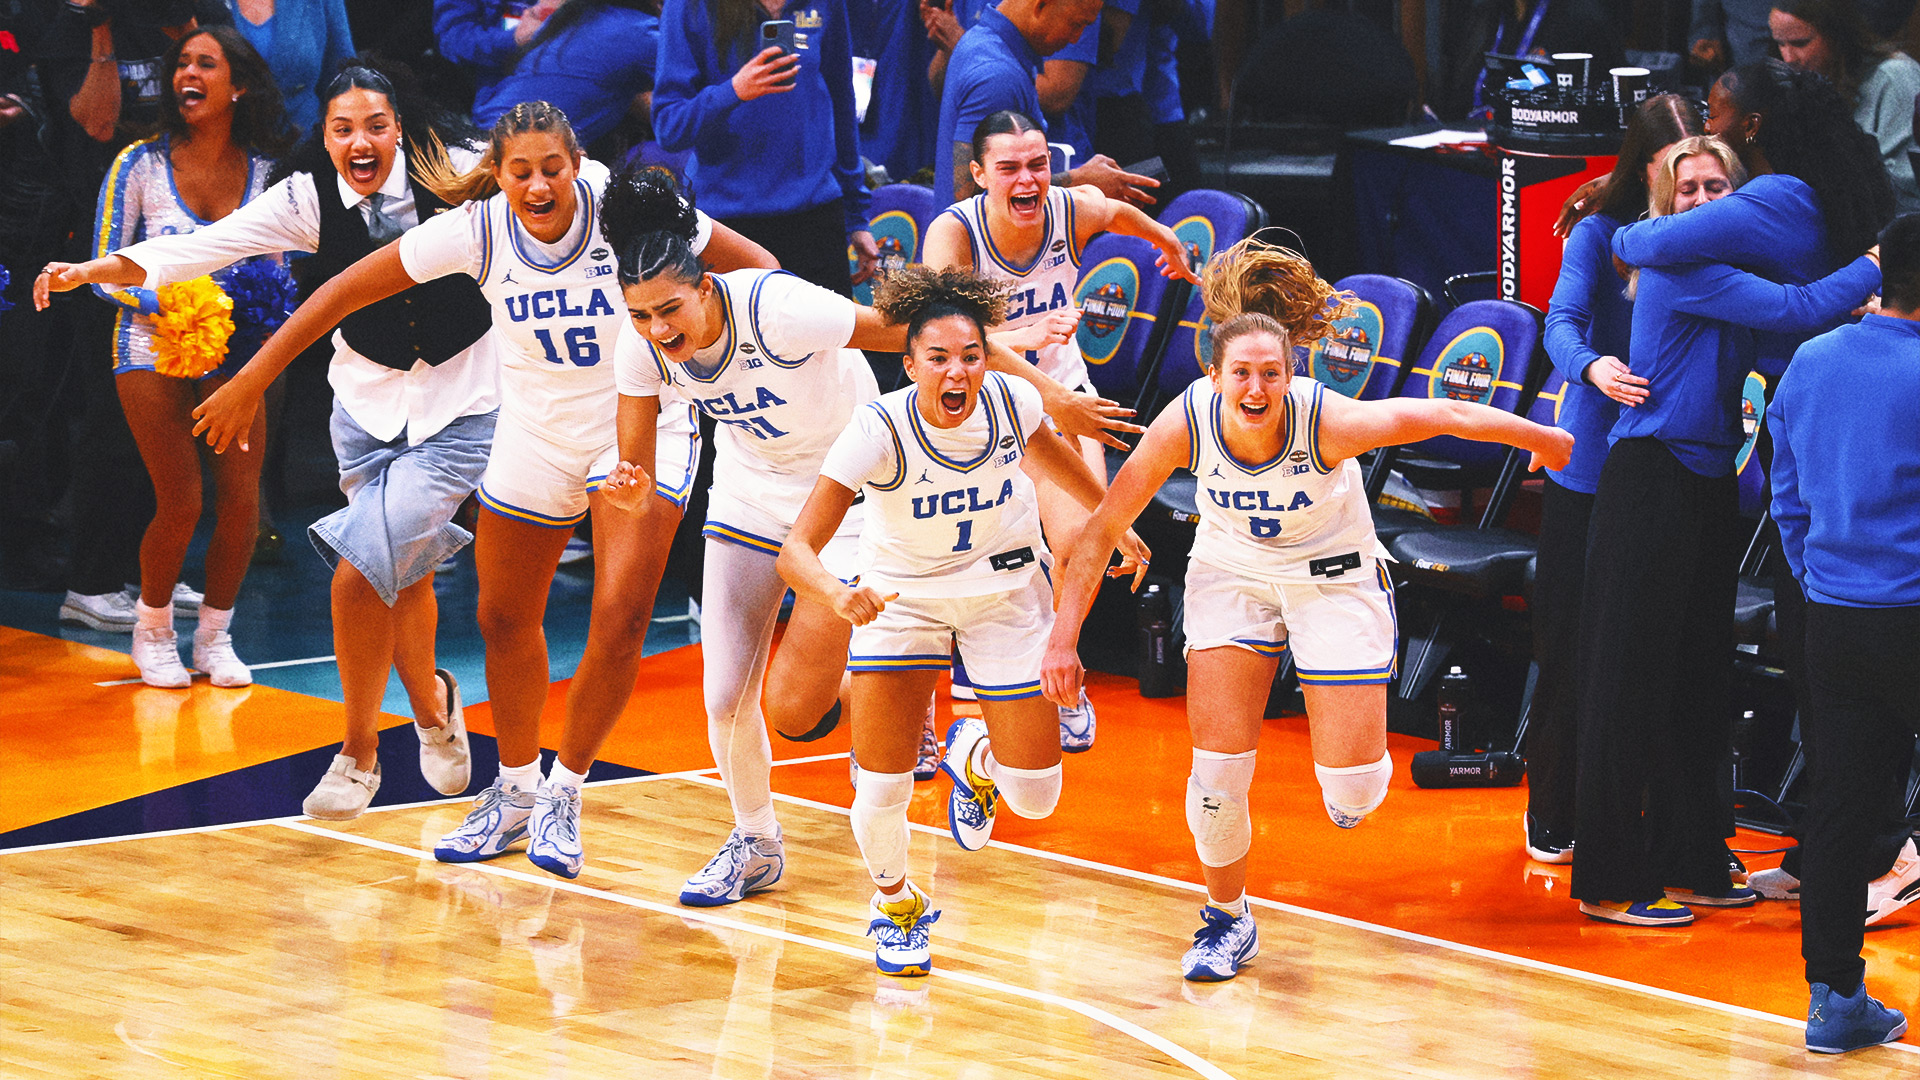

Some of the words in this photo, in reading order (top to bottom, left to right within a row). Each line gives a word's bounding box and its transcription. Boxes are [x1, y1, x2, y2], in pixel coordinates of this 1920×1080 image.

[1511, 107, 1579, 124] BODYARMOR
[1502, 158, 1515, 301] ODYARMOR
[505, 288, 615, 322] UCLA
[1006, 282, 1068, 322] CLA
[533, 326, 601, 367] 16
[1443, 367, 1469, 386] FINAL
[1468, 372, 1492, 388] FOUR
[911, 478, 1013, 520] UCLA
[1206, 488, 1314, 512] UCLA
[951, 519, 973, 552] 1
[1444, 719, 1452, 750] ARMOR
[1449, 766, 1481, 775] YARMOR
